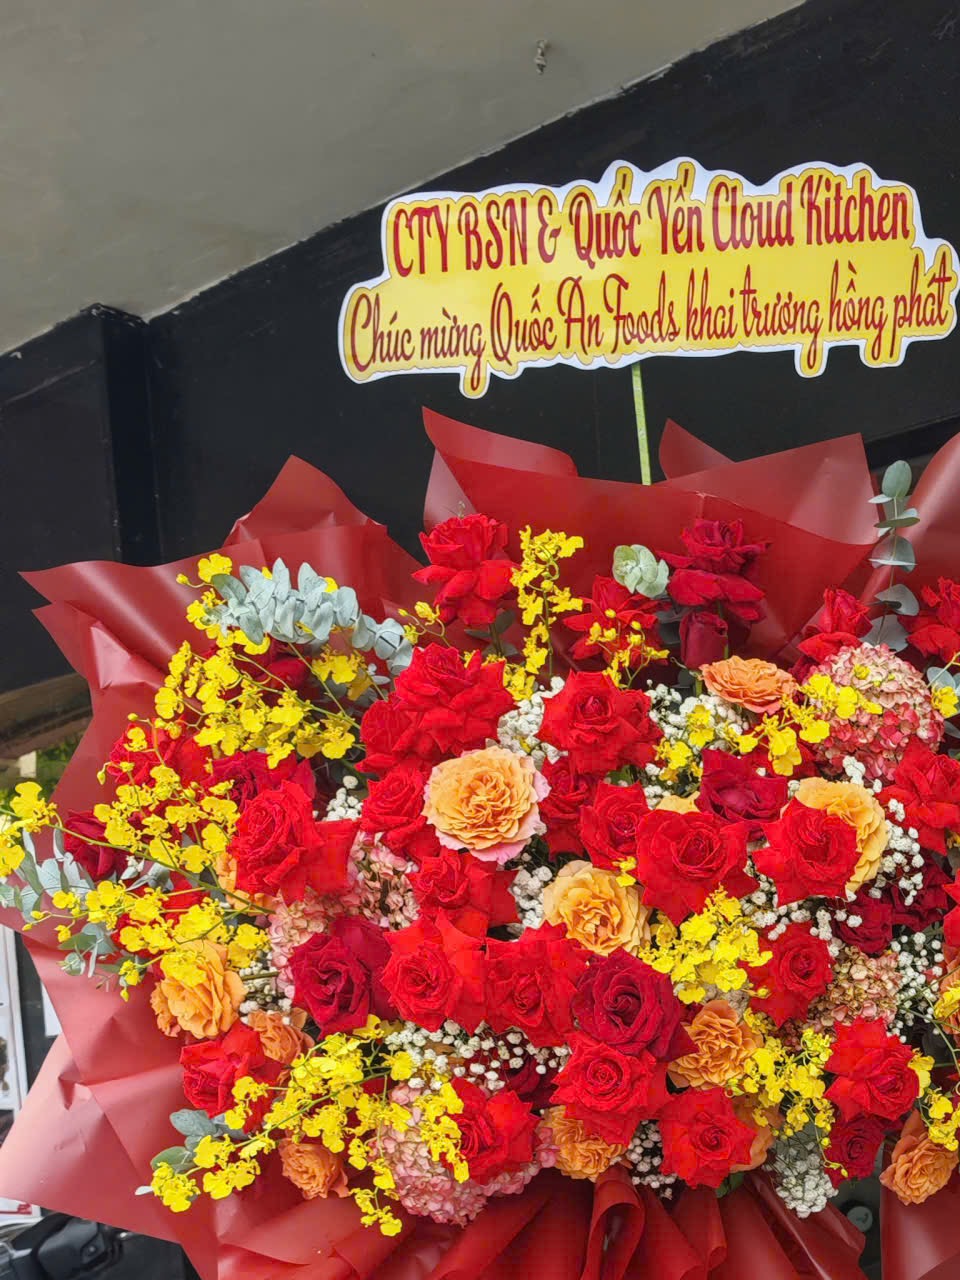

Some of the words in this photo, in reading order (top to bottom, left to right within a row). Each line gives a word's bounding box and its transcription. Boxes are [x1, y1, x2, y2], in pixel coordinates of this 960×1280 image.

[392, 204, 450, 277] CTY
[458, 197, 528, 271] BSN
[538, 195, 562, 264] &
[569, 173, 641, 270] Quốc
[647, 168, 705, 255] Yến
[712, 181, 795, 252] Cloud
[800, 174, 911, 246] Kitchen
[350, 292, 416, 372] Chúc
[419, 306, 486, 391] mừng
[490, 281, 557, 367] Quốc
[557, 275, 605, 356] An
[603, 270, 681, 355] Foods
[685, 266, 738, 342] khai
[738, 264, 824, 370] trương
[828, 258, 889, 361] hồng
[889, 250, 952, 358] phát
